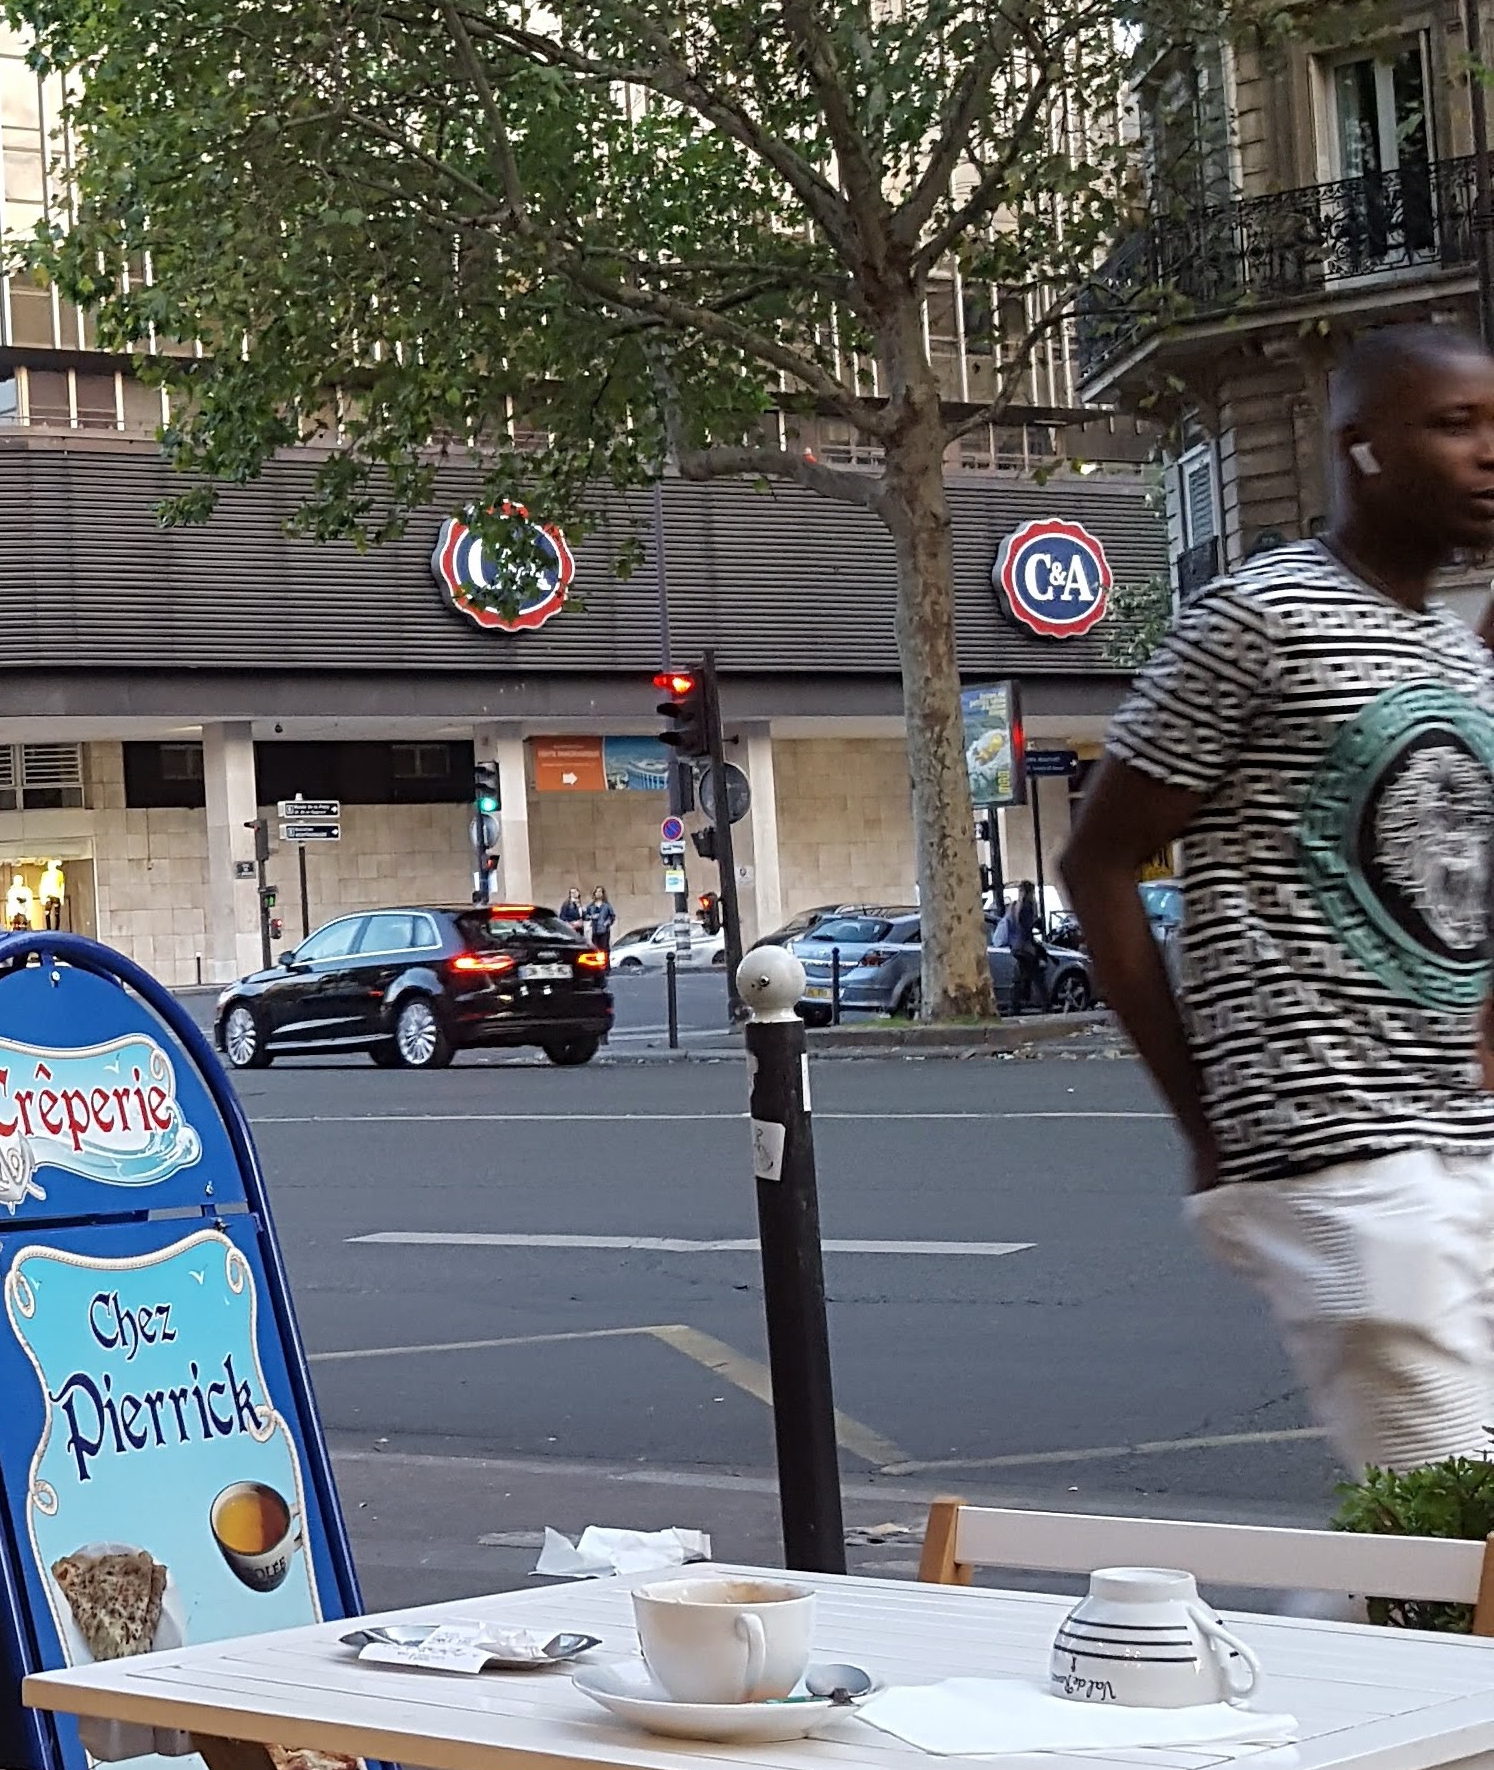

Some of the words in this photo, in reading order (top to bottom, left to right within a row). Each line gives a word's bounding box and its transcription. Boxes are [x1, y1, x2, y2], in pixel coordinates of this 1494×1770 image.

[1025, 553, 1095, 601] C&A
[89, 1291, 177, 1361] Chez
[49, 1353, 263, 1481] Pierrick
